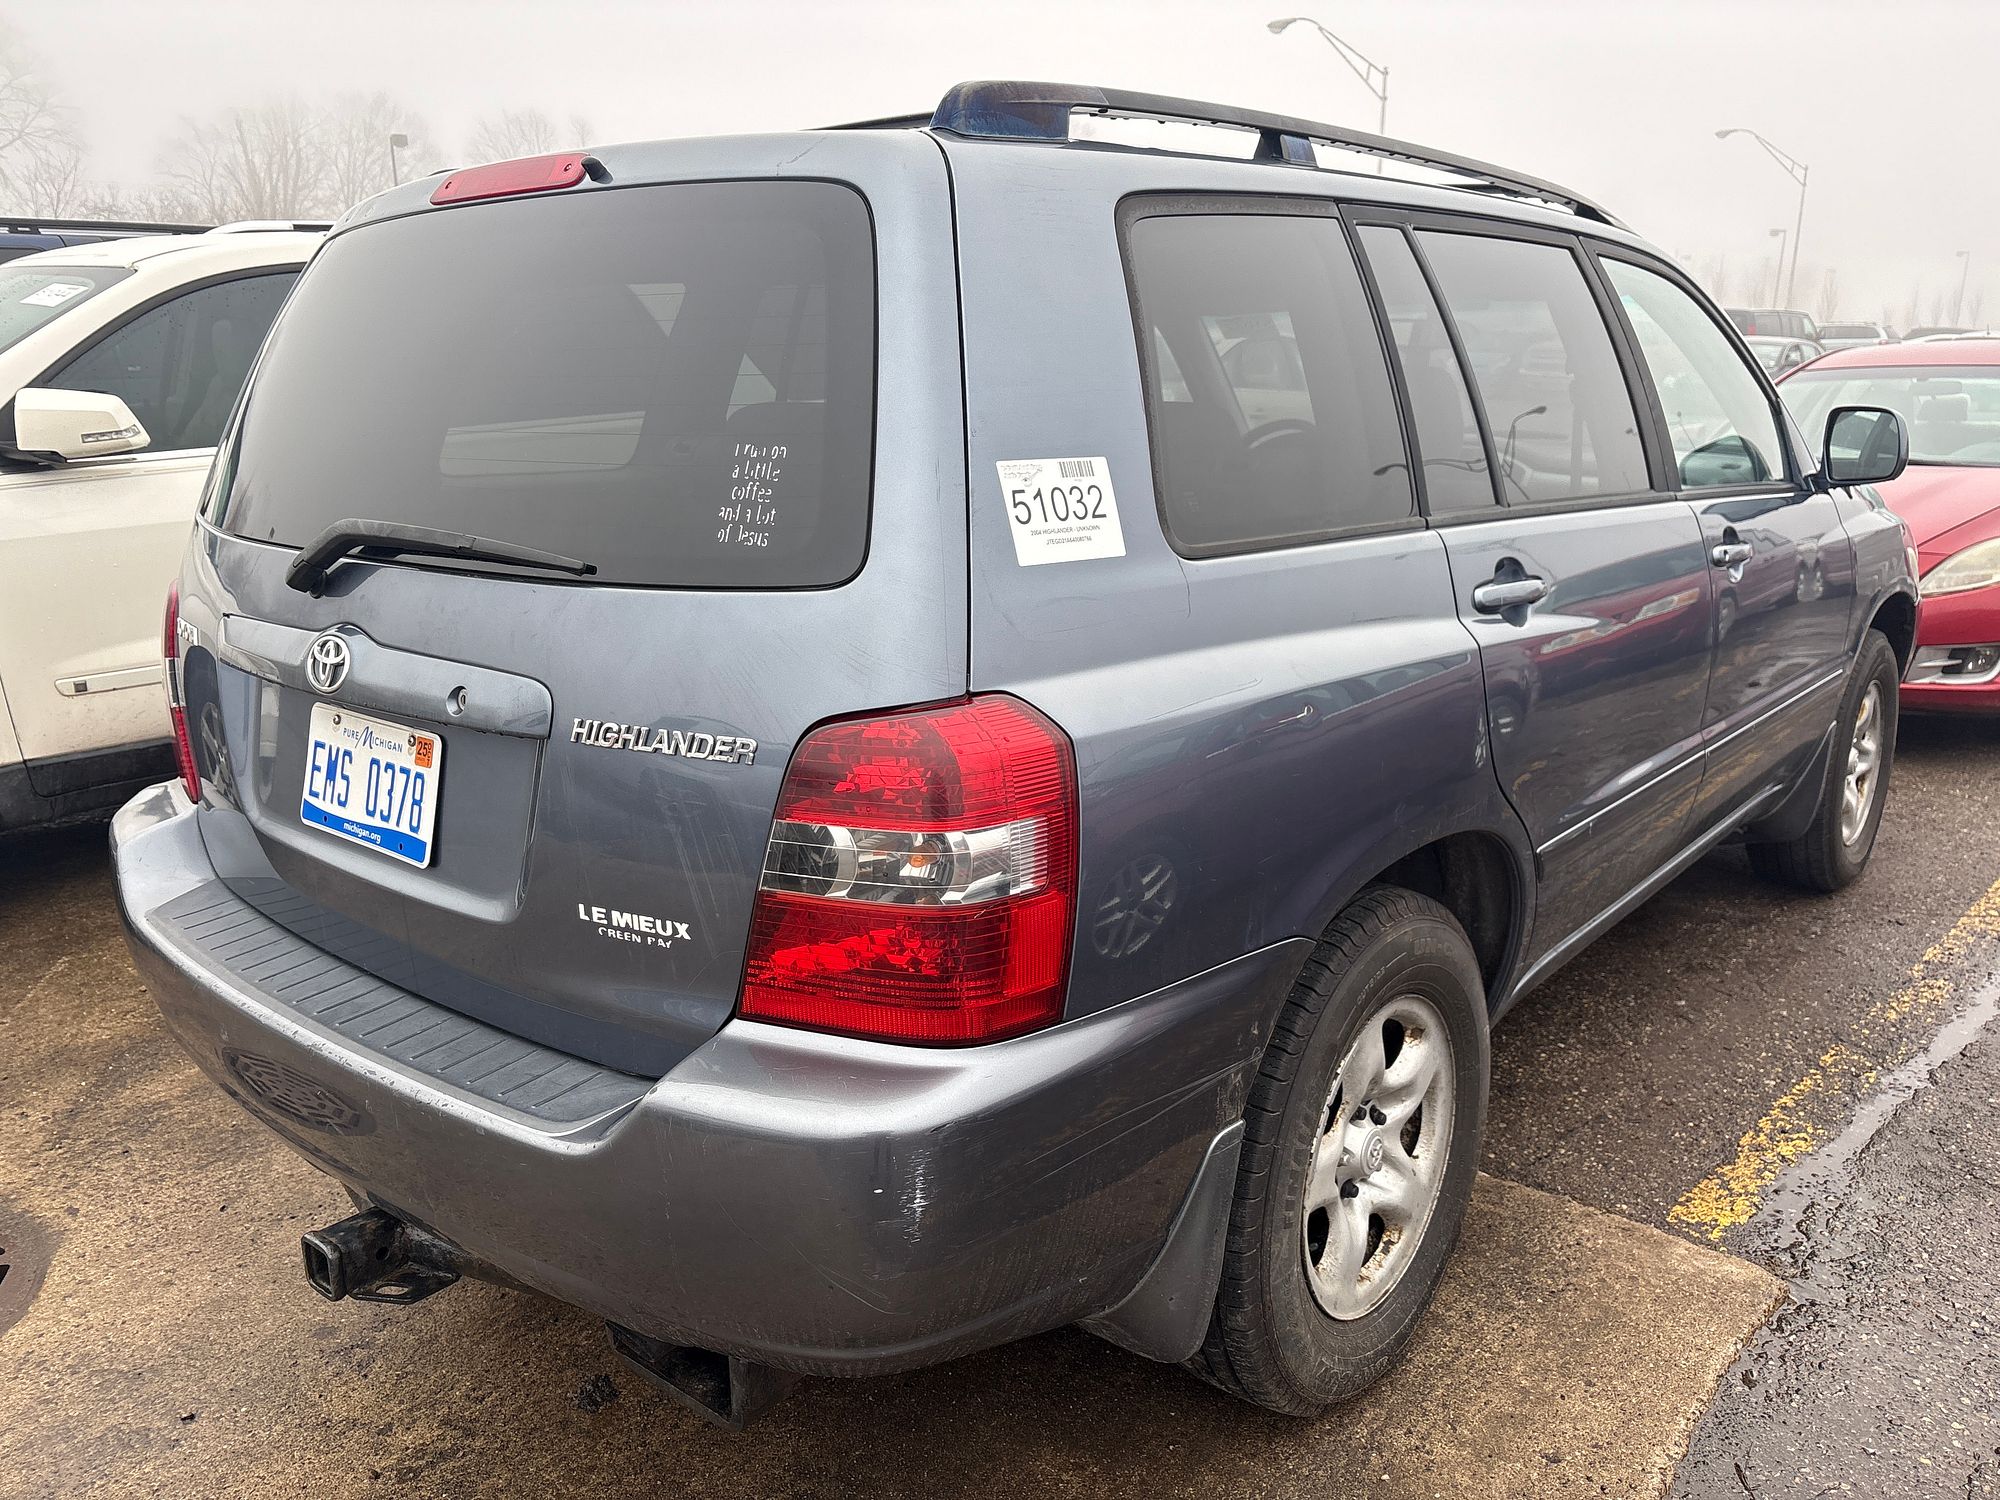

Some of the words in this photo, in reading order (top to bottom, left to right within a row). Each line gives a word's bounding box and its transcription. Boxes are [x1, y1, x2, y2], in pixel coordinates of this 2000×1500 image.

[732, 464, 740, 479] a
[744, 460, 781, 481] little
[731, 481, 772, 503] coffee
[718, 503, 741, 522] and
[746, 508, 752, 523] a
[756, 504, 777, 526] lot
[1011, 484, 1107, 525] 51032
[717, 523, 733, 543] of
[735, 524, 769, 546] Jesus
[343, 727, 359, 740] PURE
[355, 725, 403, 753] MICHIGAN
[417, 740, 428, 757] 25
[570, 717, 758, 765] HIGHLANDER
[308, 739, 353, 808] EMS
[365, 756, 426, 835] 0378
[343, 822, 382, 844] michigan.org
[578, 903, 608, 925] LE
[611, 910, 691, 940] MIEUX
